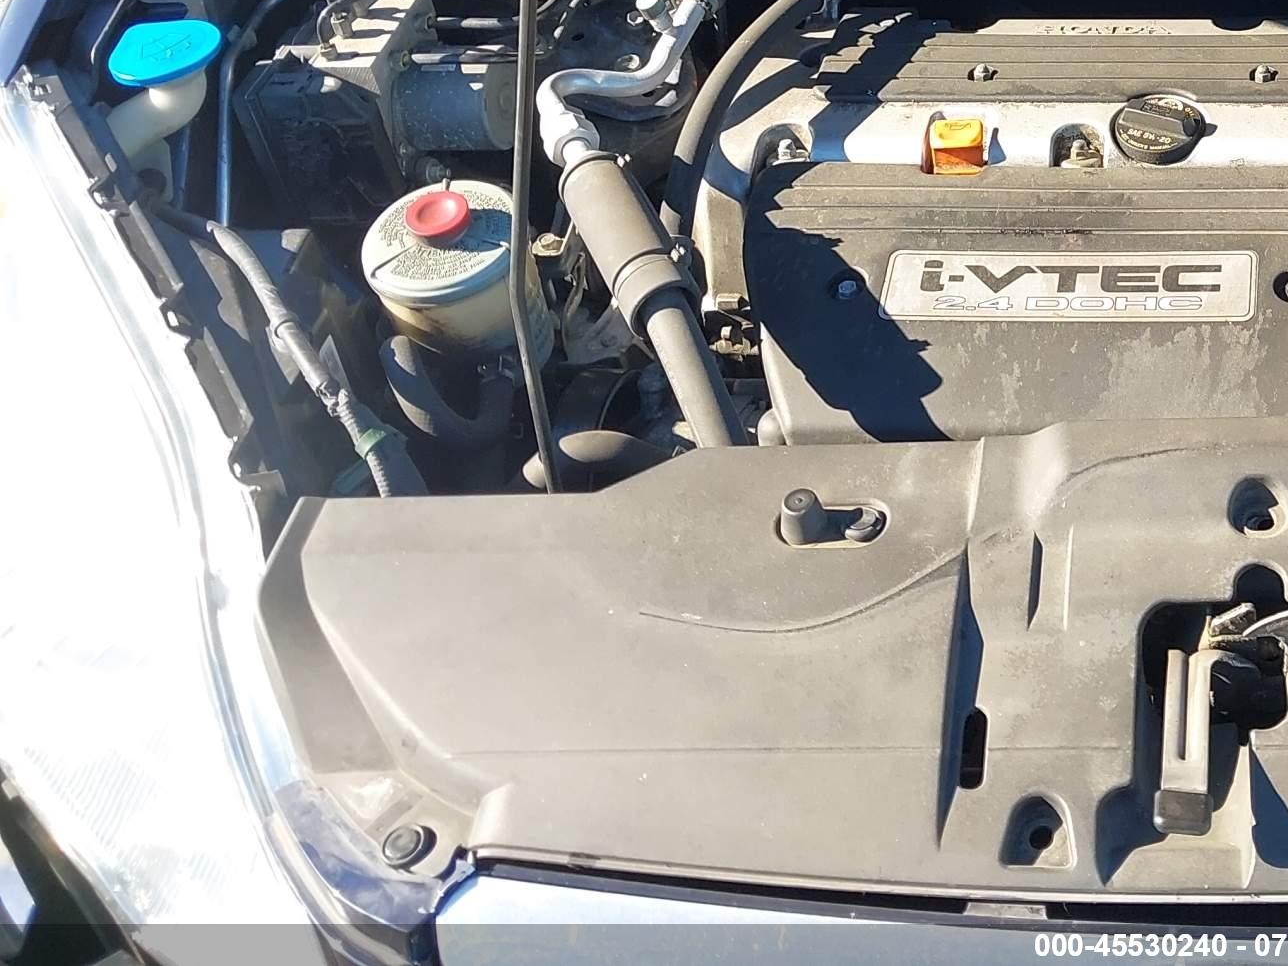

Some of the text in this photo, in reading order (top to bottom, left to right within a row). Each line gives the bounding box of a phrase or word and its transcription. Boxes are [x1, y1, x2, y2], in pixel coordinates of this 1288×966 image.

[1037, 25, 1172, 35] HONDA
[1126, 128, 1142, 138] SAE
[919, 259, 1223, 294] i-VTEC
[931, 295, 1203, 311] 2.4 DOHC
